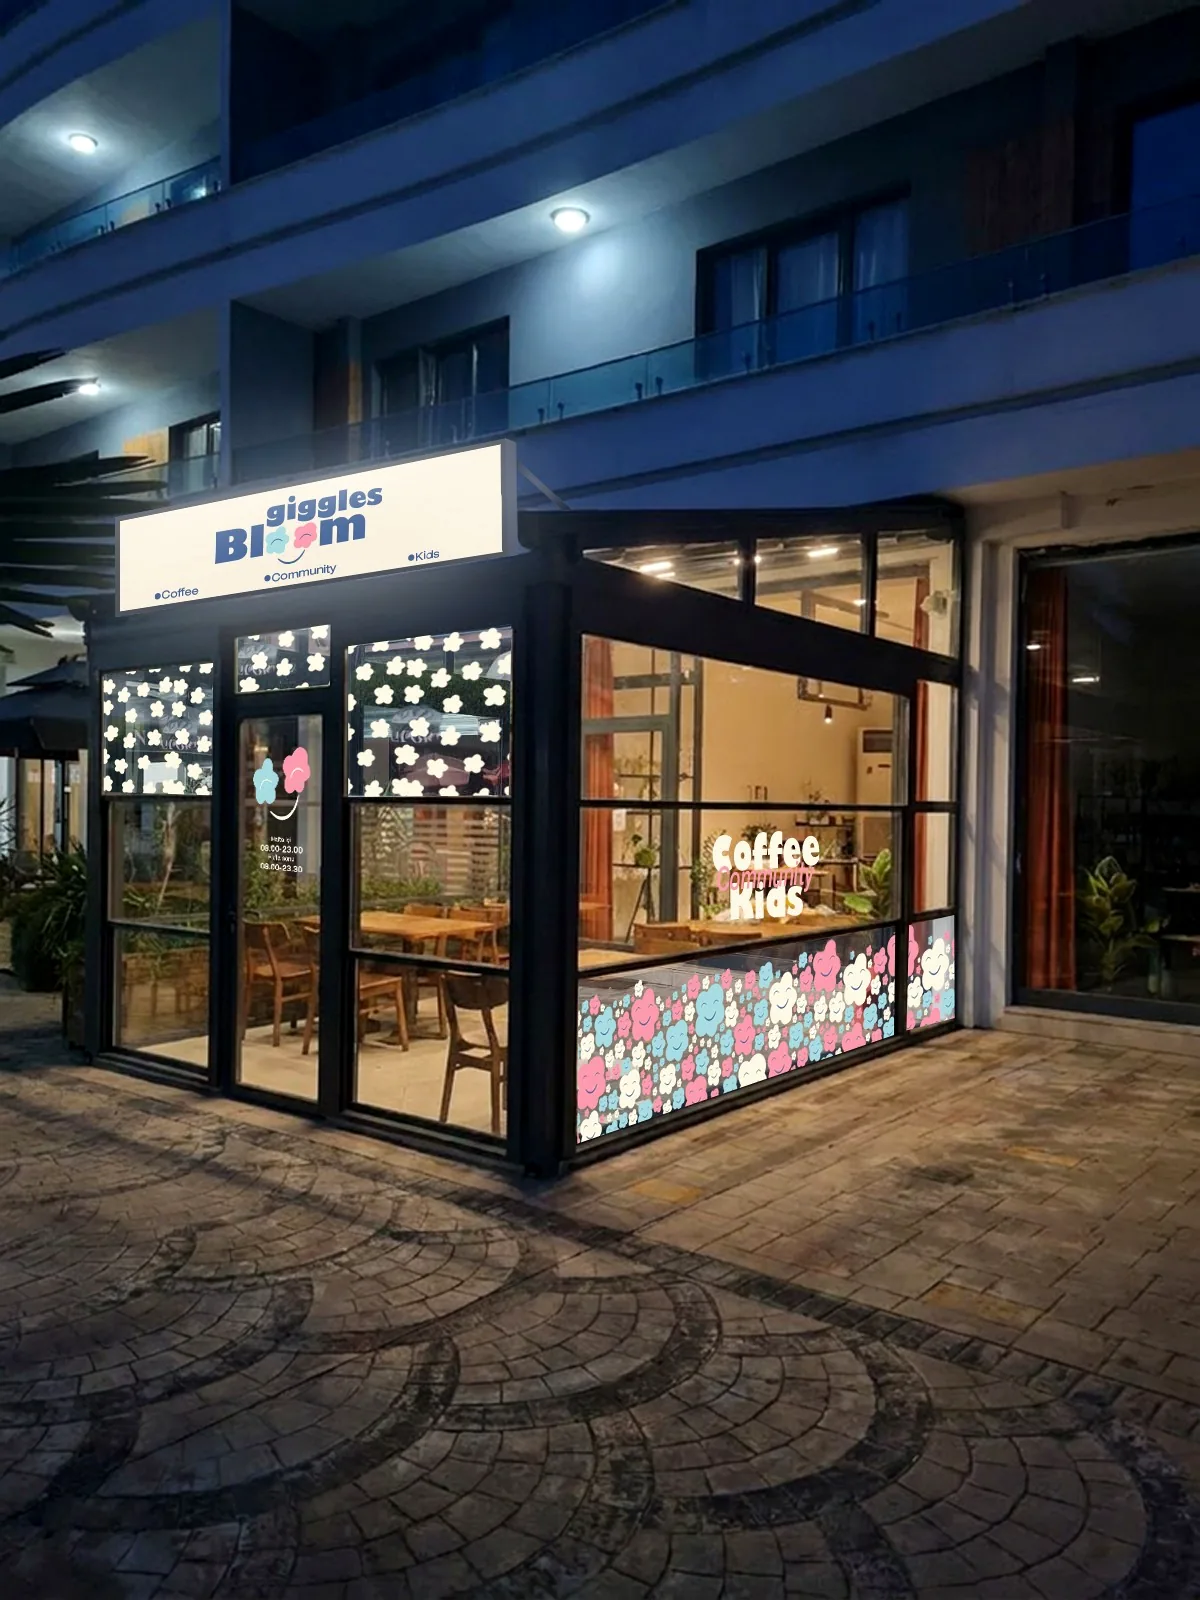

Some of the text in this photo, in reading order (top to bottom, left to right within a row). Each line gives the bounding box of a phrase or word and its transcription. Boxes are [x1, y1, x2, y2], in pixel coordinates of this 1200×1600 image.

[266, 487, 383, 527] giggles
[414, 549, 440, 562] Kids
[271, 564, 337, 583] Community
[161, 586, 199, 601] Coffee
[712, 831, 820, 871] Coffee
[716, 861, 816, 892] Community
[729, 880, 804, 920] Kids
